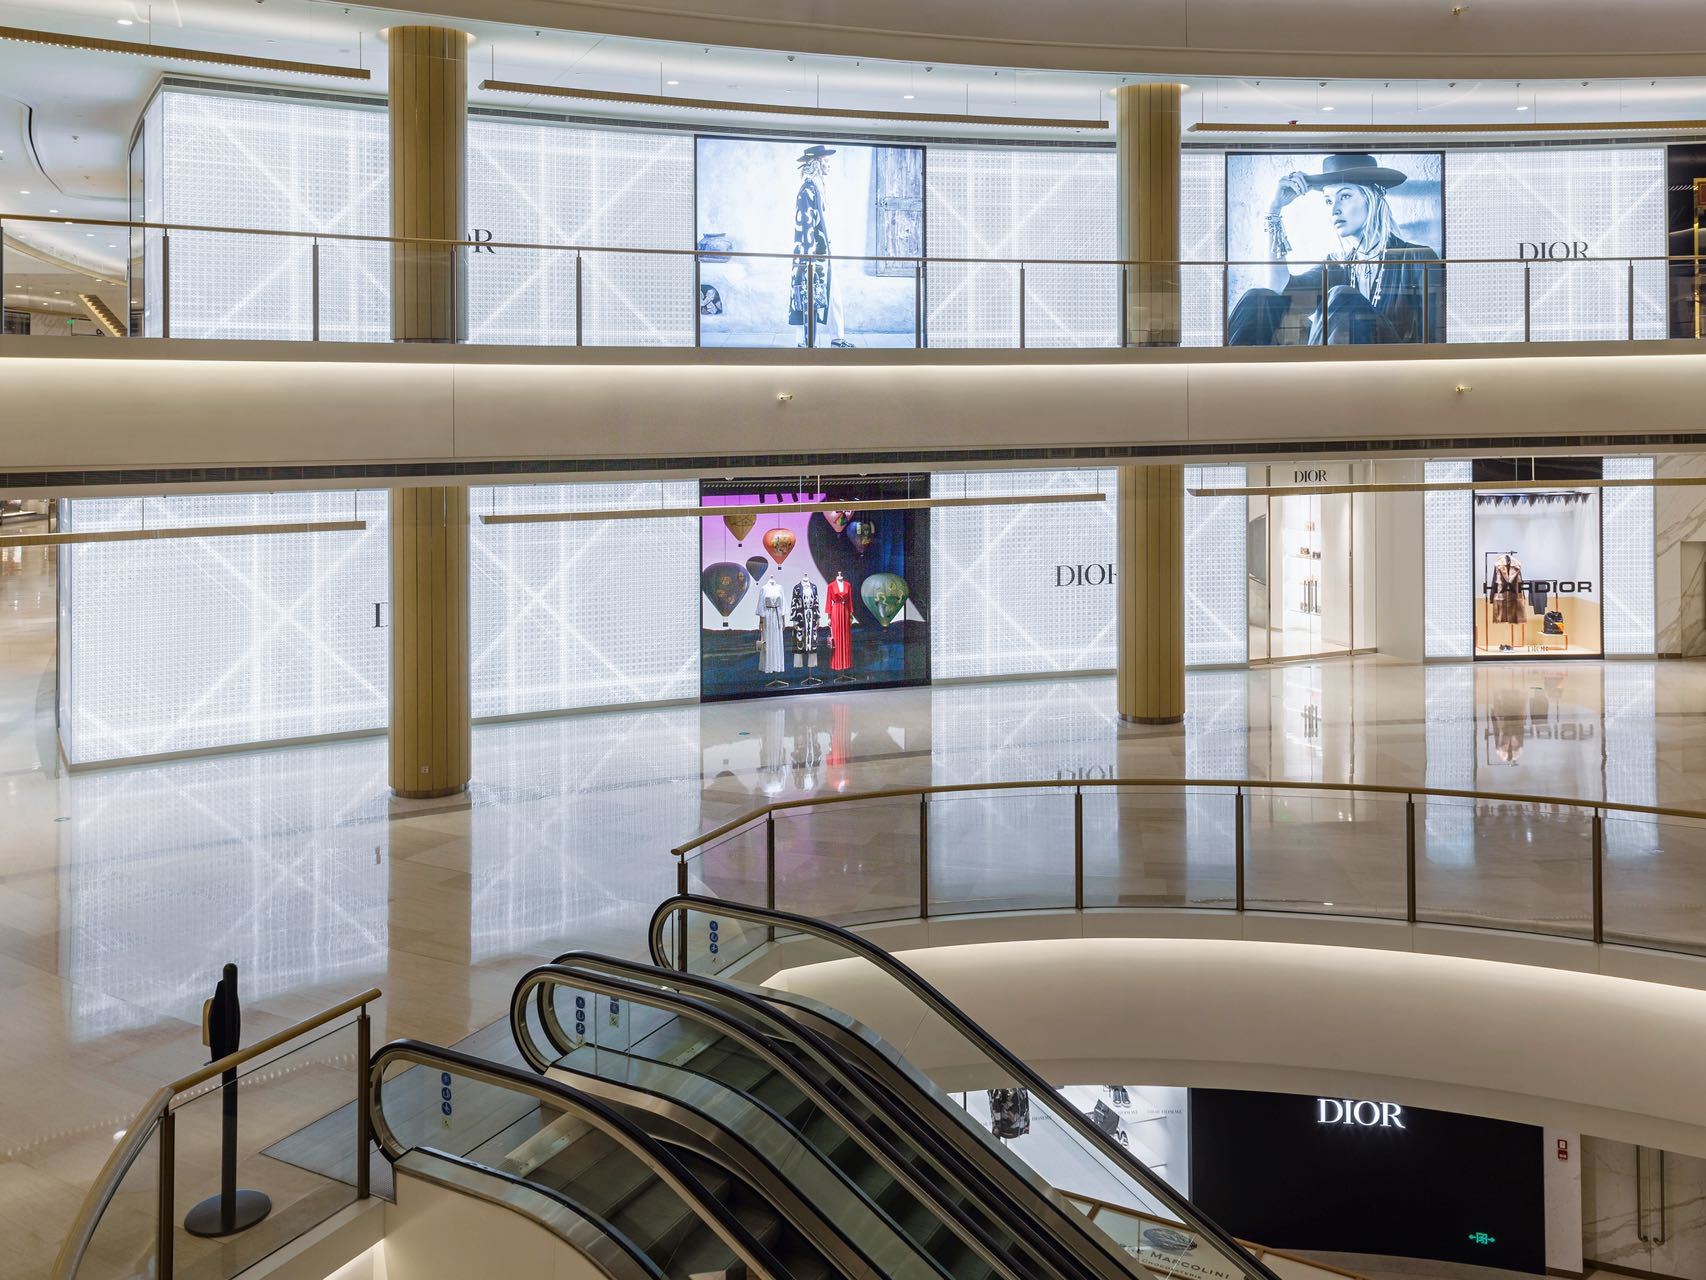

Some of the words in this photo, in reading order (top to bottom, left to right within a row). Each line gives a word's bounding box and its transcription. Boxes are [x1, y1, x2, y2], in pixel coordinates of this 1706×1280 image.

[467, 228, 496, 254] R
[1517, 241, 1589, 262] DIOR
[1294, 469, 1328, 483] DIOR
[1317, 1098, 1406, 1129] DIOR
[1151, 1251, 1229, 1279] MARCOLINI
